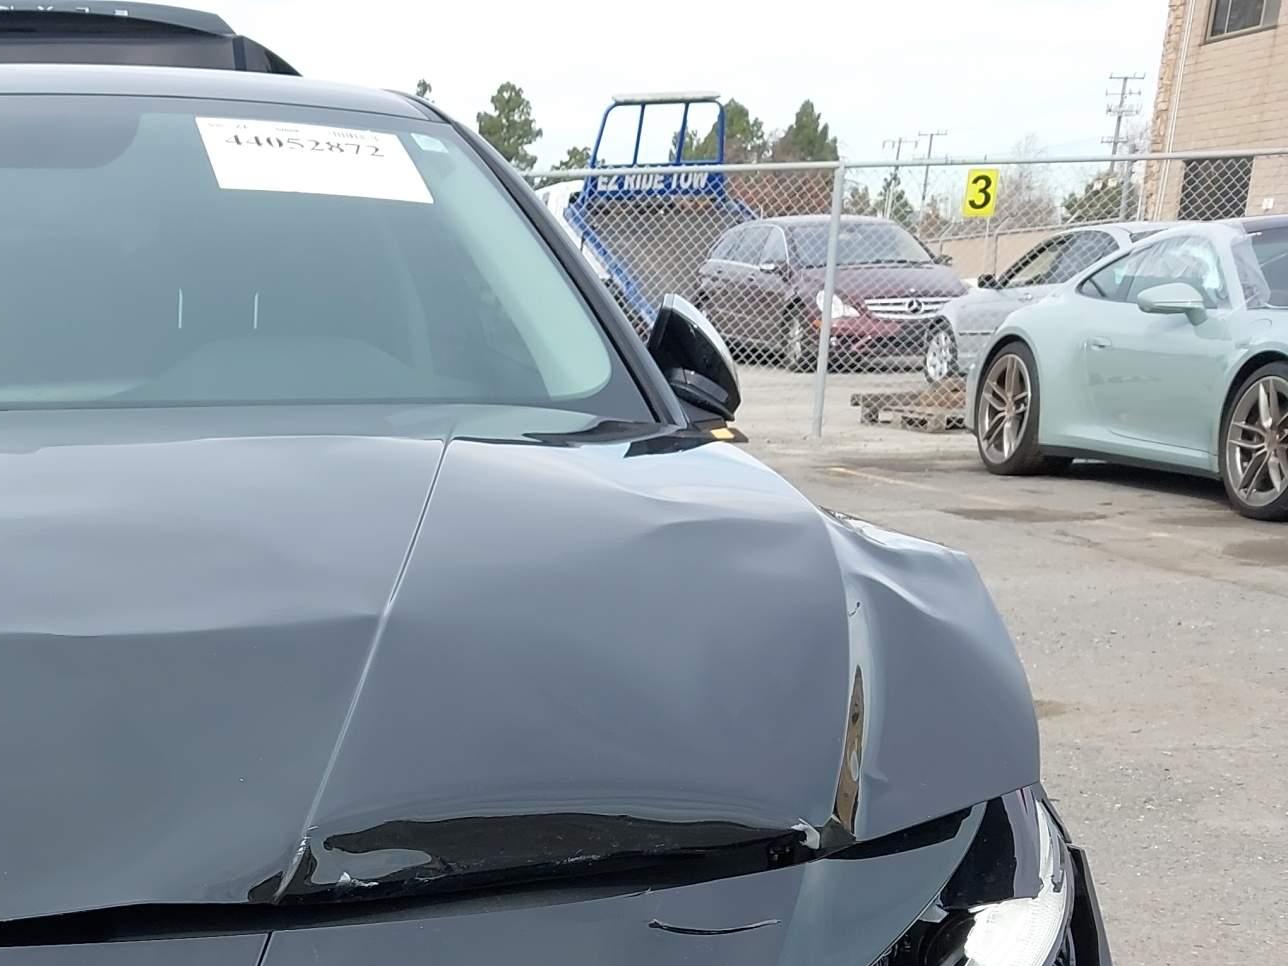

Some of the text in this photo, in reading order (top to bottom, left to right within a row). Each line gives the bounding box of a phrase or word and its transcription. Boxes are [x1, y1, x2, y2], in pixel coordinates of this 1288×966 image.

[225, 134, 385, 158] 44052872
[597, 171, 709, 191] EZ RIDE TOW
[968, 174, 992, 209] 3
